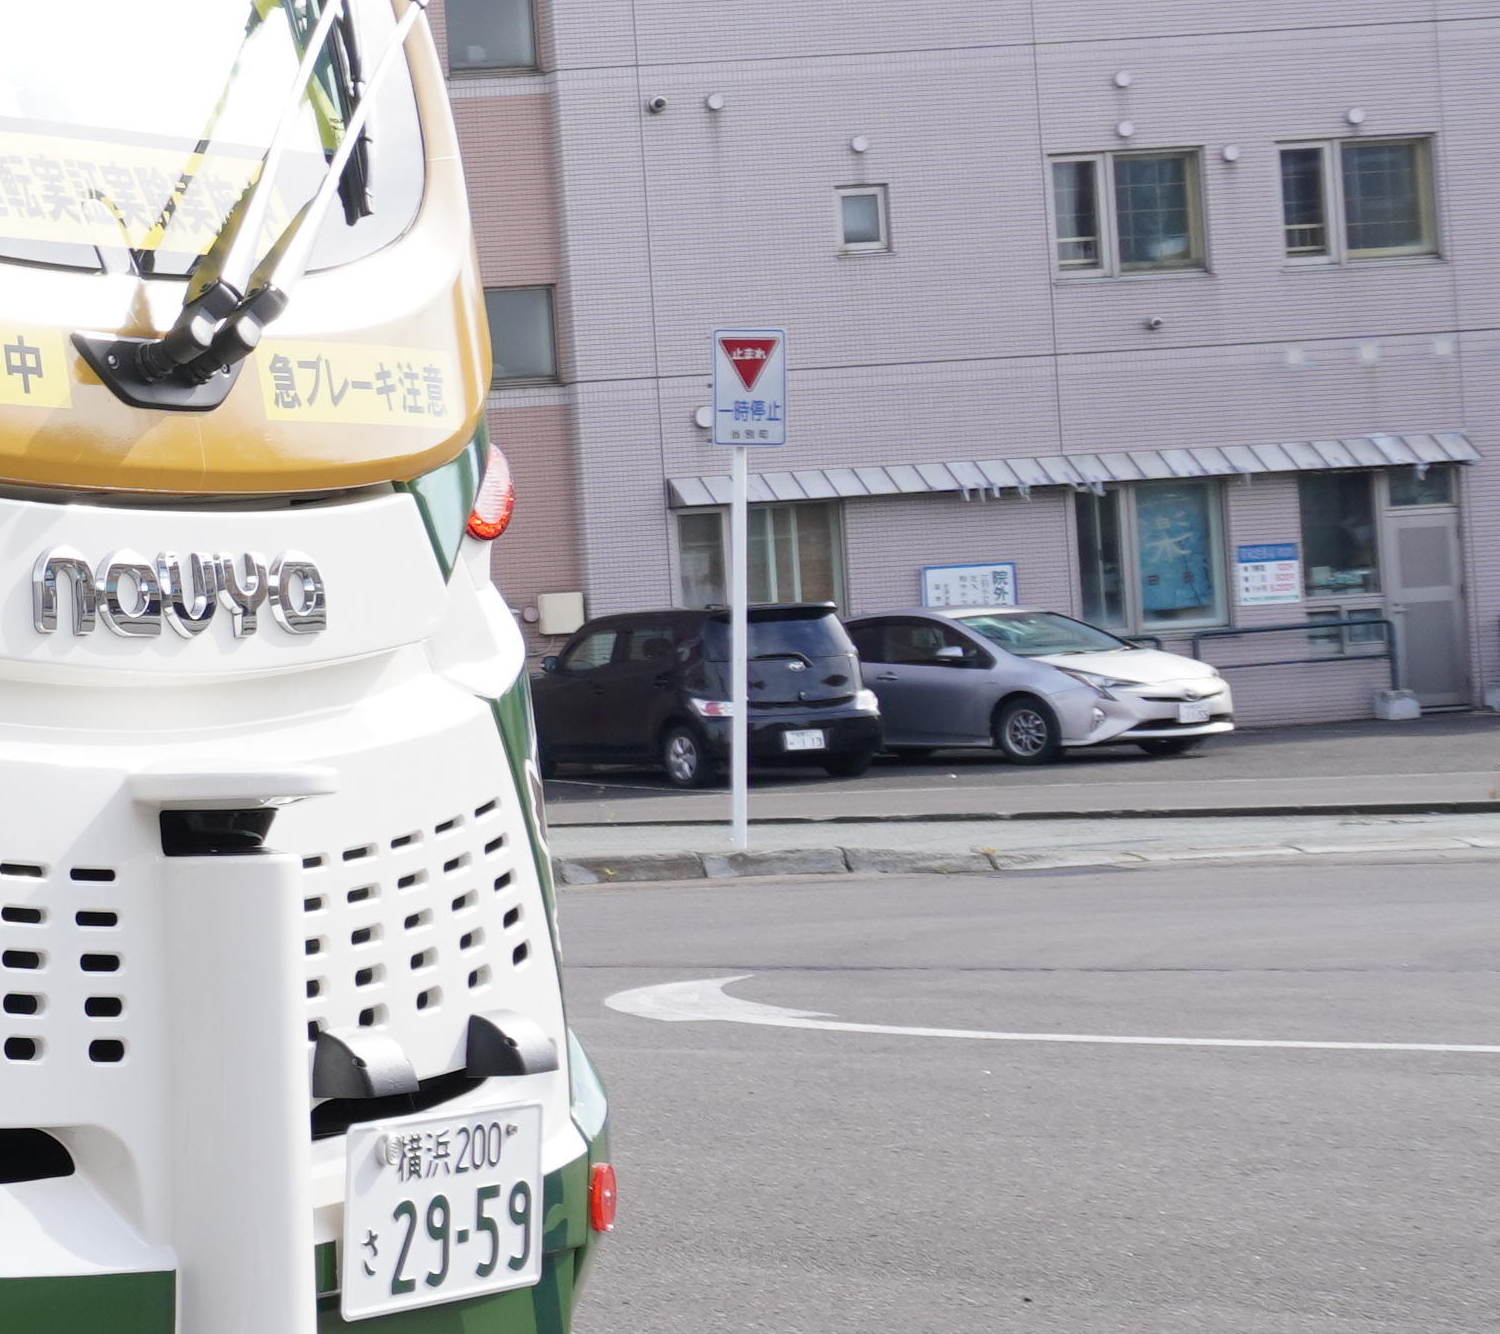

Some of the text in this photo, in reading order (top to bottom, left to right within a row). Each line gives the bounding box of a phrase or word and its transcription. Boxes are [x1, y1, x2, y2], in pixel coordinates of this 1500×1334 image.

[731, 348, 767, 360] 止まれ
[271, 352, 450, 419] 急ブレーキ注意
[718, 400, 782, 422] 一時停止
[362, 1179, 533, 1296] さ 29-59
